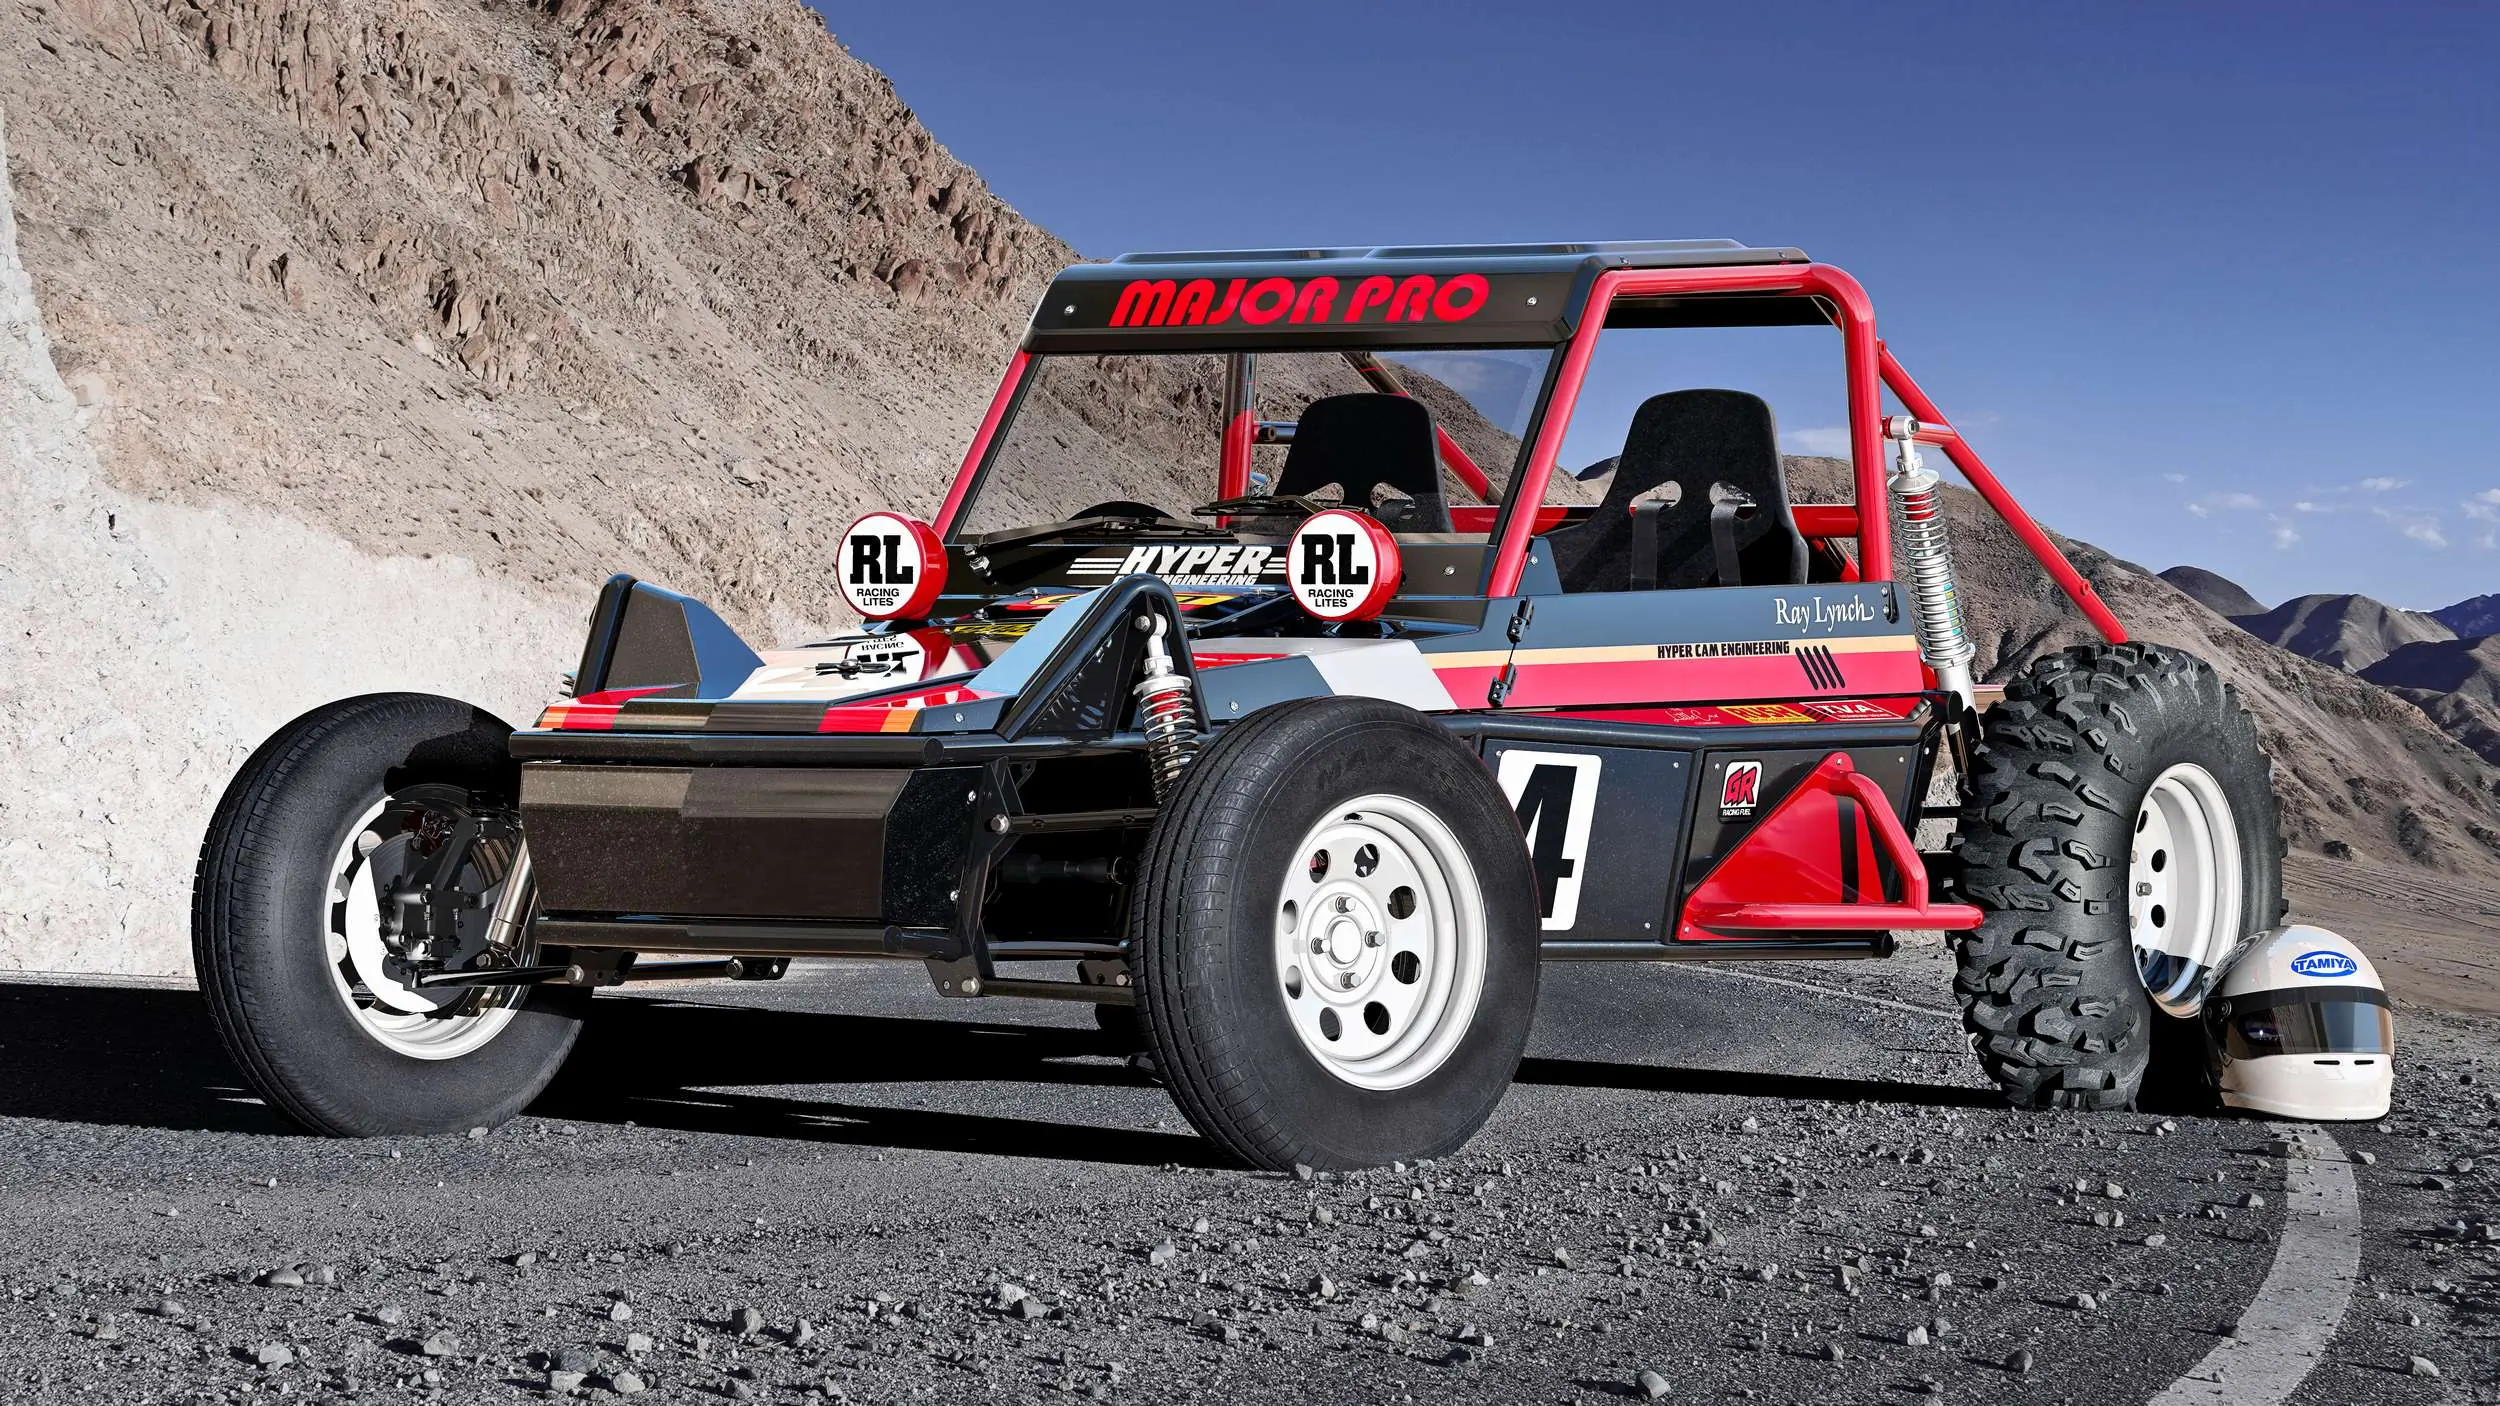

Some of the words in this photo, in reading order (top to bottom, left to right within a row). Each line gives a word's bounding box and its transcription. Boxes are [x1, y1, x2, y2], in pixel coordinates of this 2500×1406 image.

[1108, 276, 1340, 327] MAJOR
[1343, 273, 1490, 323] PRO
[849, 534, 914, 585] RL
[1117, 545, 1273, 574] HYPER
[1300, 533, 1369, 585] RL
[1156, 574, 1258, 585] NGINEERING
[856, 587, 900, 597] RACING
[1308, 588, 1354, 598] RACING
[863, 597, 894, 607] LITES
[1314, 598, 1348, 608] LITES
[1773, 597, 1811, 634] Ray
[1813, 593, 1876, 633] Lynch
[1657, 644, 1693, 659] HYPER
[1695, 642, 1719, 658] CAM
[1721, 640, 1790, 657] ENGINEERING
[1723, 765, 1758, 807] GR
[1722, 808, 1740, 817] RACING
[1740, 808, 1752, 816] FUEL
[1515, 764, 1576, 919] 4
[2295, 957, 2354, 971] TAMIYA
